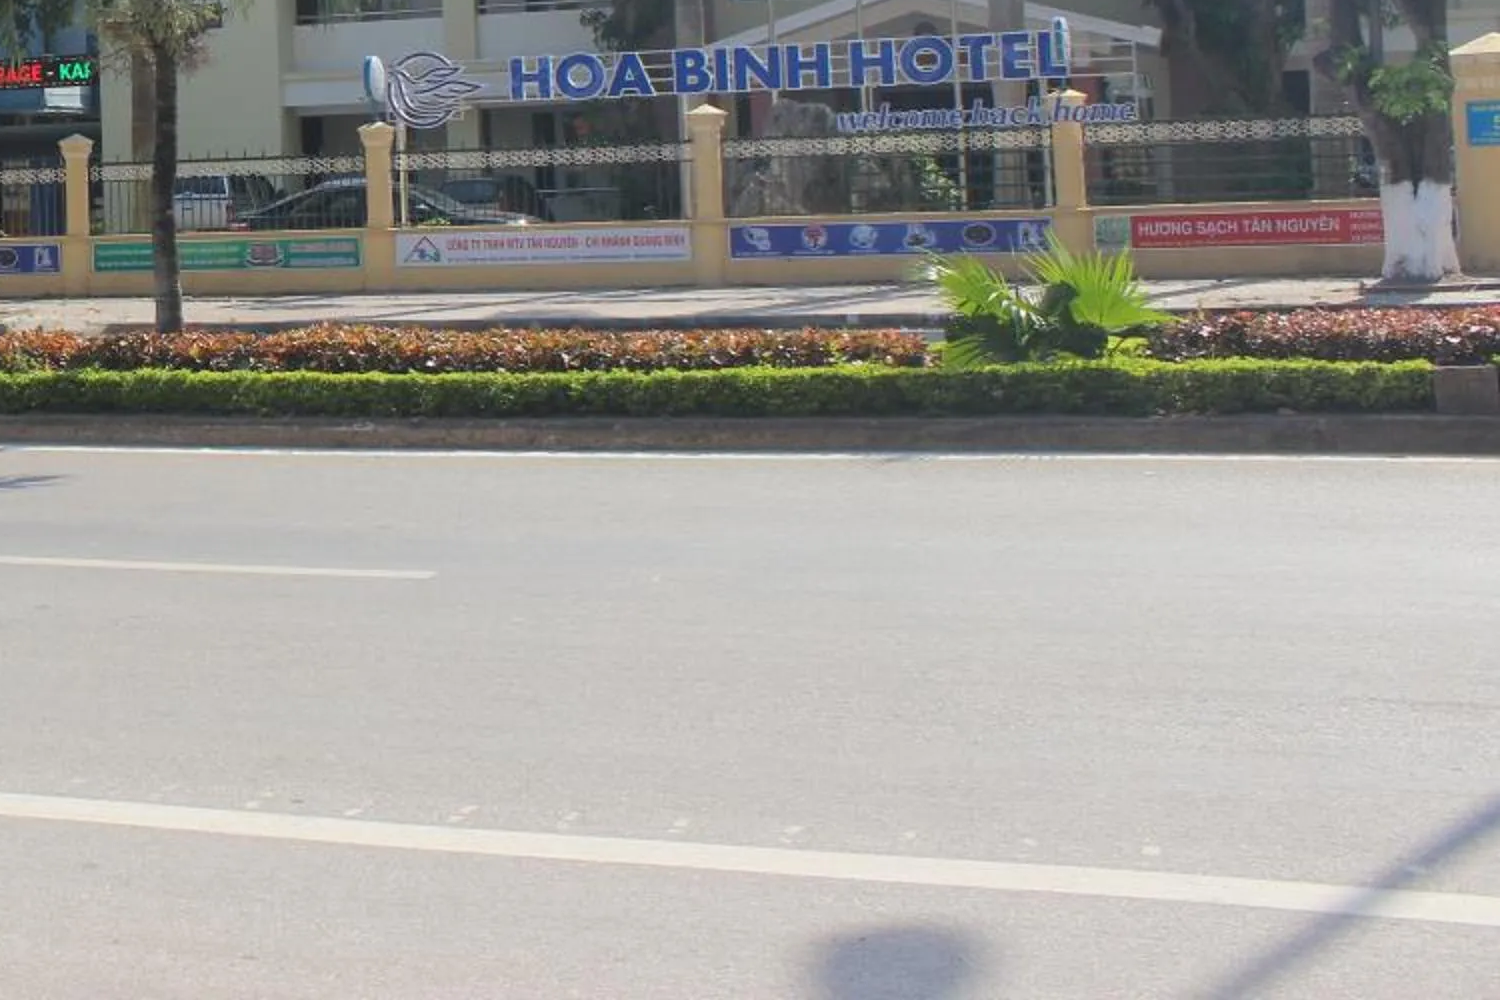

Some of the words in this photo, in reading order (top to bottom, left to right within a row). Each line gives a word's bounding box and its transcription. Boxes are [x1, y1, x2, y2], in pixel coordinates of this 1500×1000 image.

[509, 51, 657, 102] HOA
[672, 42, 833, 95] BINH
[848, 30, 1070, 87] HOTEL
[836, 102, 964, 133] welcome
[969, 96, 1042, 127] back
[1050, 96, 1137, 124] home
